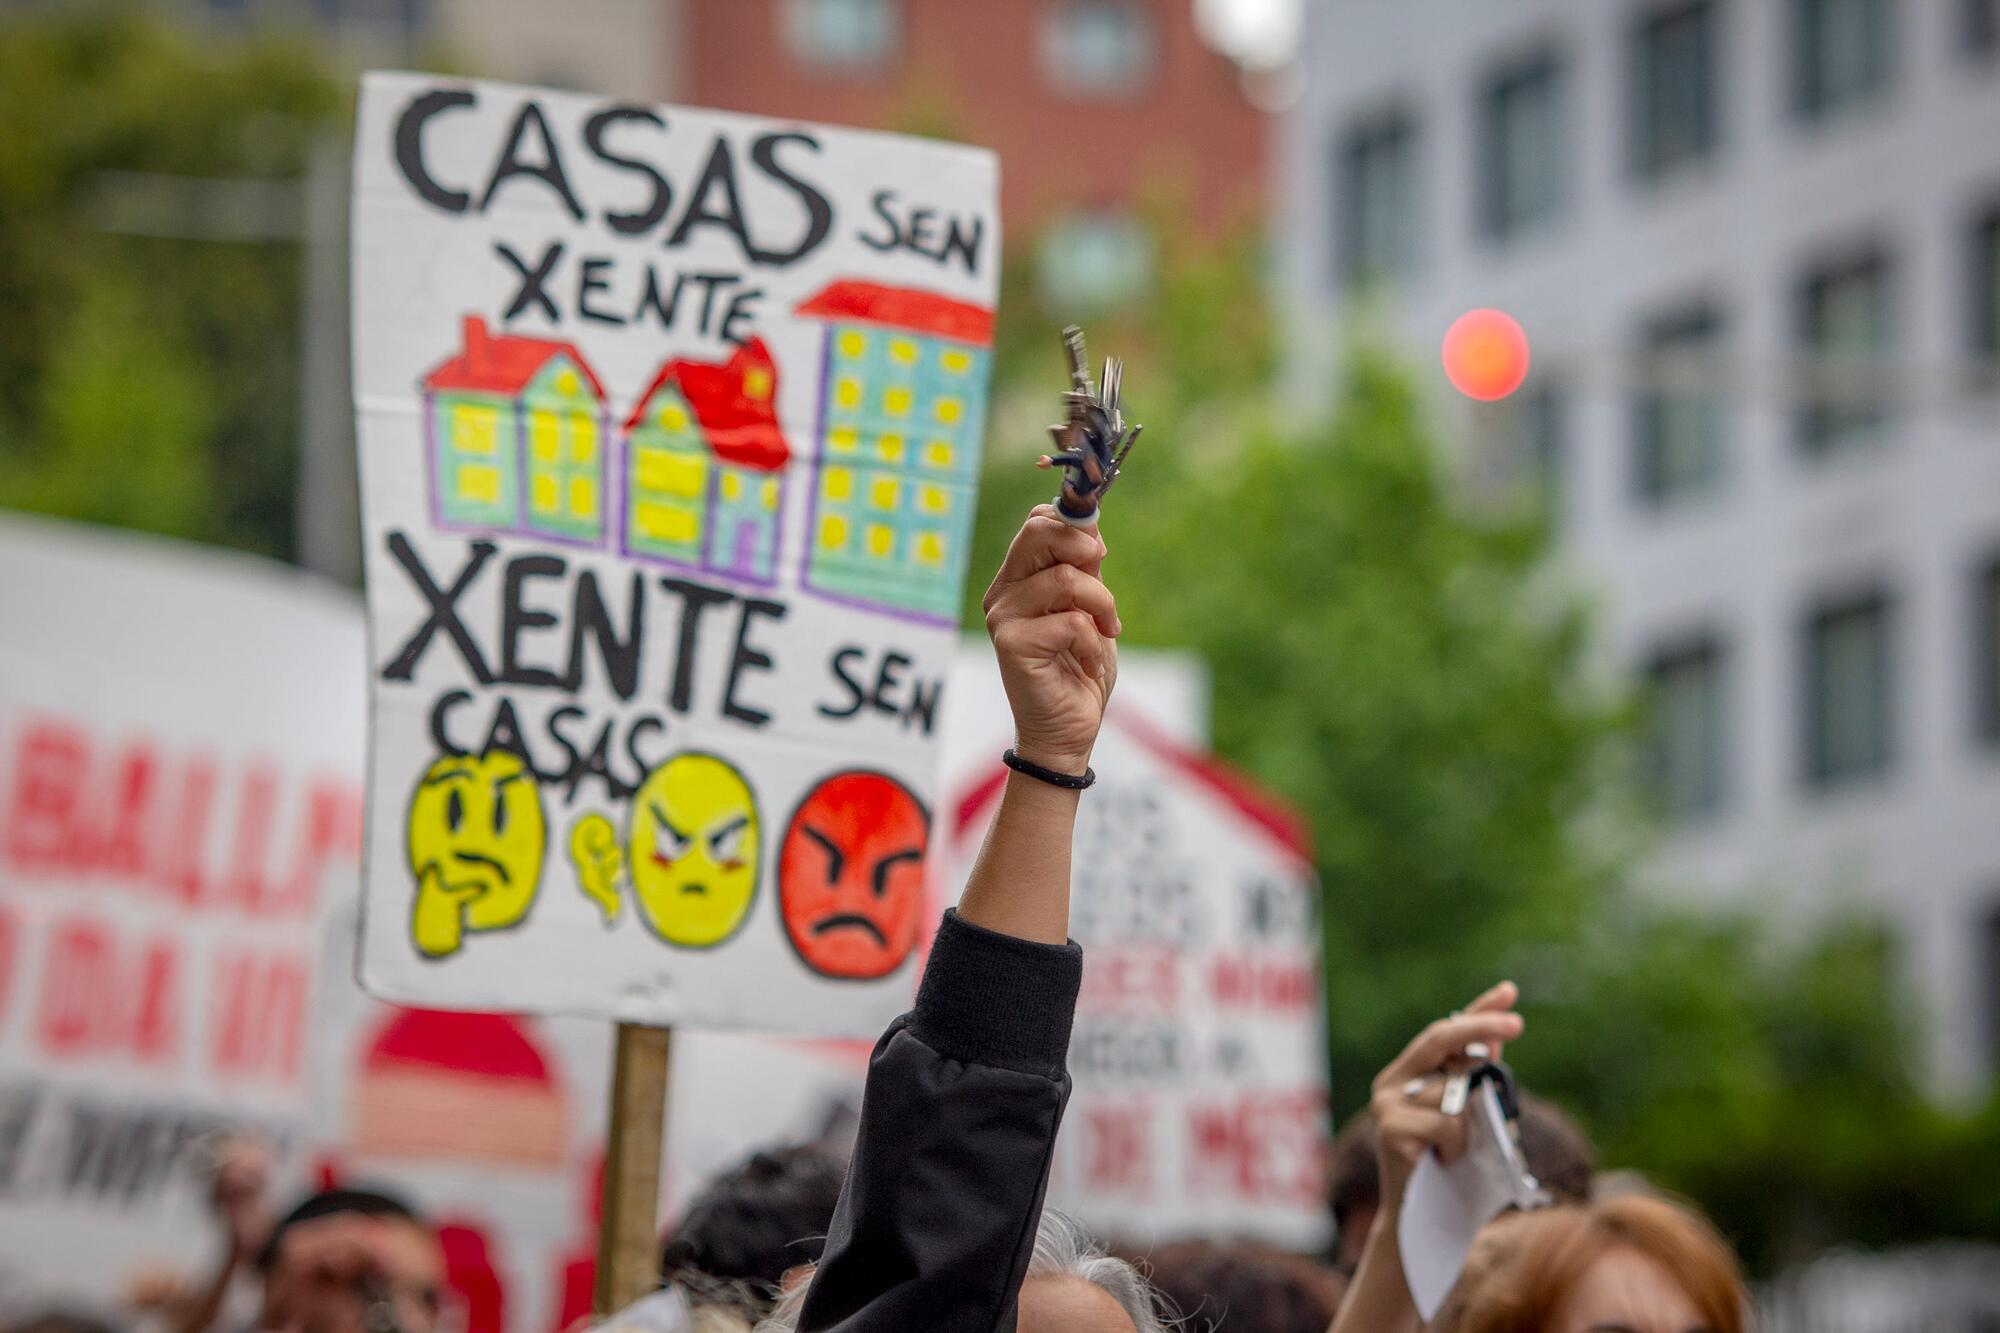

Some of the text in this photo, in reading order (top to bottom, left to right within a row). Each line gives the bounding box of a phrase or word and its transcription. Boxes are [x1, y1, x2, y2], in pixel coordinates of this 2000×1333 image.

[393, 89, 984, 277] CASAS SEN
[493, 240, 764, 346] XENTE
[382, 530, 946, 739] XENTE SEN
[430, 690, 668, 806] CASAS
